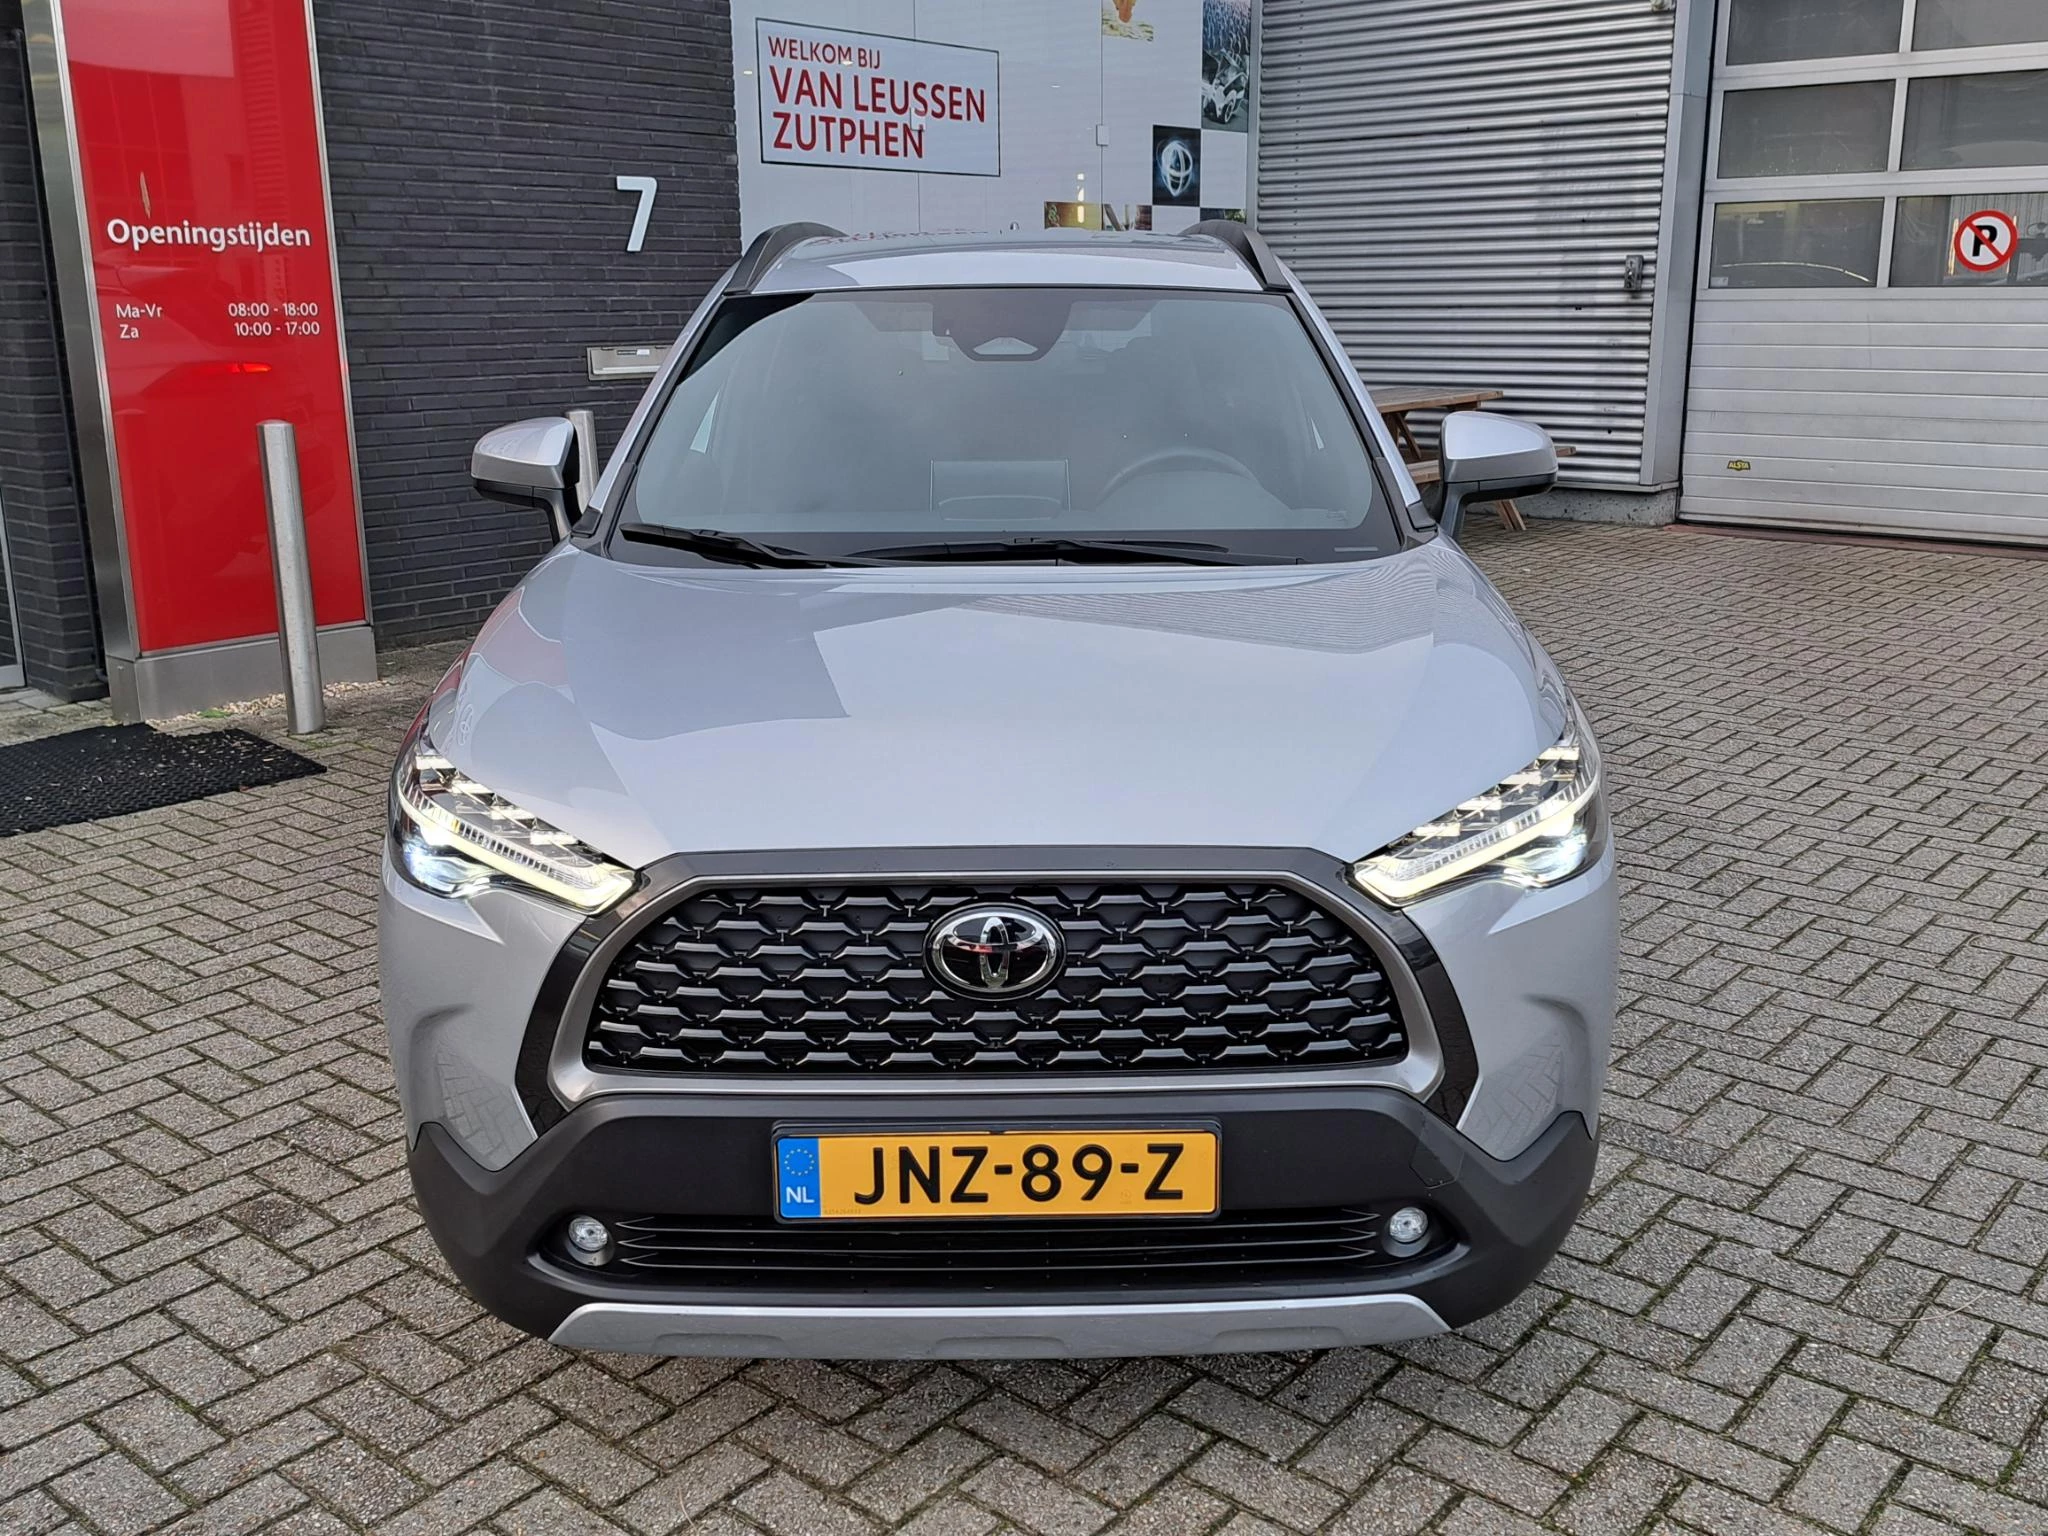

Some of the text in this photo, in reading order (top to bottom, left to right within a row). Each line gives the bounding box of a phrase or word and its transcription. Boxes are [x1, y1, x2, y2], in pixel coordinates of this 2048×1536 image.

[768, 36, 880, 69] WELKOM BIJ
[769, 65, 985, 123] VAN LEUSSEN
[772, 111, 923, 159] ZUTPHEN
[616, 175, 657, 252] 7
[107, 218, 311, 252] Openingstijden
[115, 303, 163, 318] Ma-Vr
[228, 302, 270, 317] 08:00
[282, 302, 319, 317] 18:00
[119, 323, 140, 339] Za
[234, 321, 272, 336] 10:00
[285, 321, 320, 336] 17:00
[786, 1143, 1185, 1205] NL JNZ-89-Z
